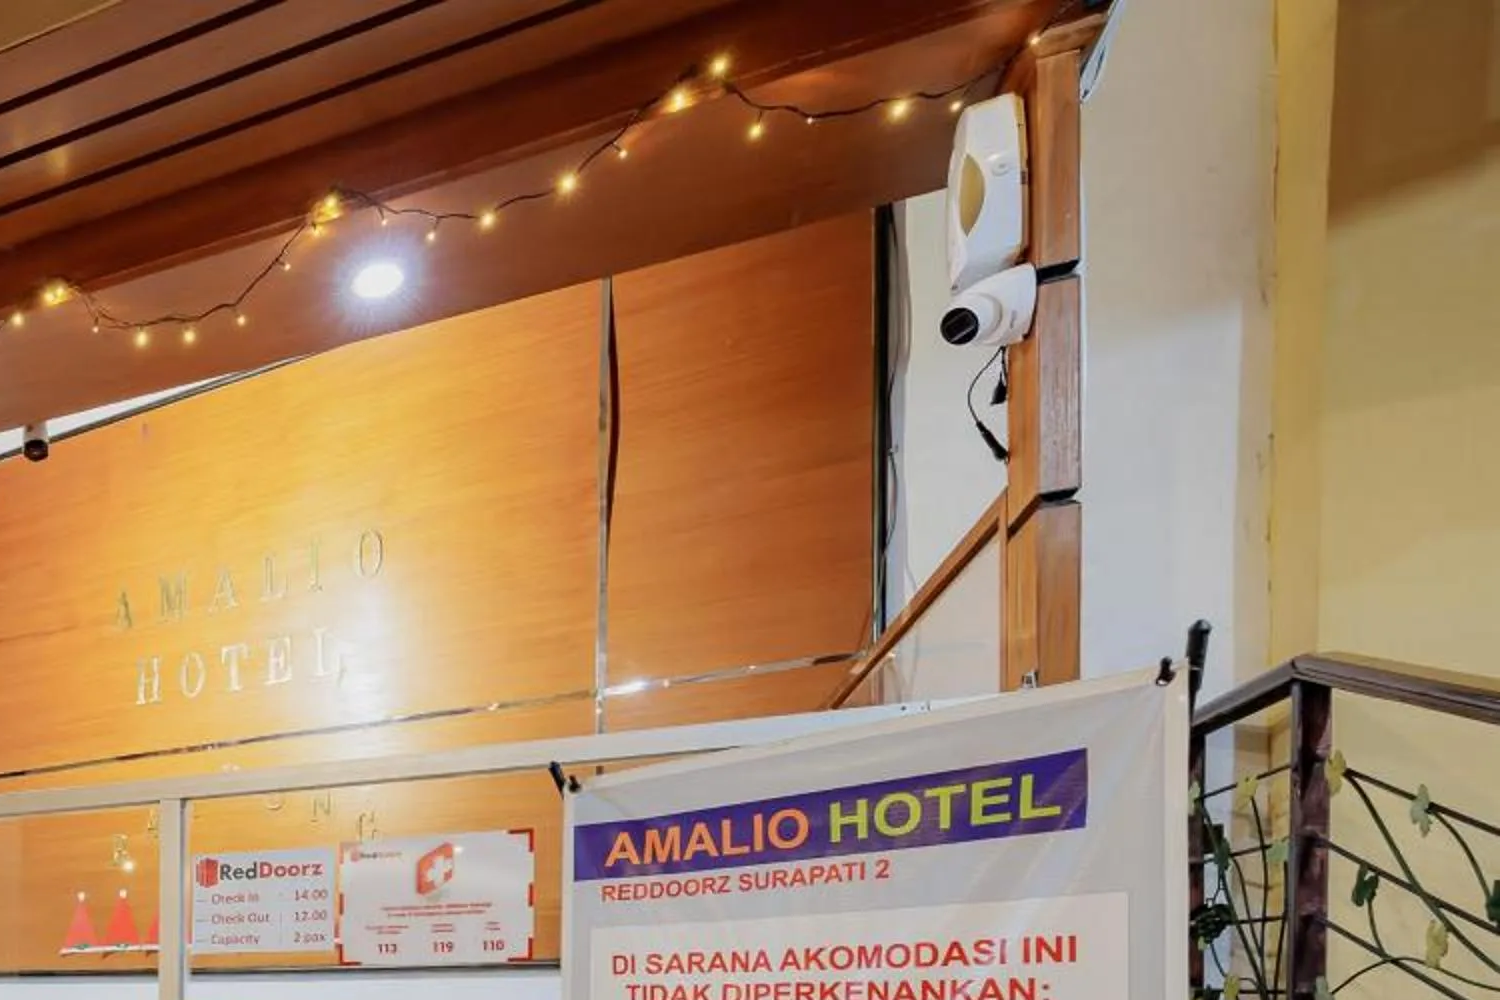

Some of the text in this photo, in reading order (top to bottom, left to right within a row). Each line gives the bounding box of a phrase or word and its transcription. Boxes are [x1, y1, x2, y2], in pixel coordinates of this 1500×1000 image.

[115, 529, 383, 628] AMALIO
[136, 627, 345, 704] HOTEL
[604, 773, 1062, 867] AMALIO HOTEL
[219, 861, 324, 881] RedDoorz
[601, 859, 890, 902] REDDOORZ SURAPATI 2
[211, 893, 245, 905] Check
[211, 913, 245, 925] Check
[247, 912, 269, 923] Out
[211, 933, 261, 946] Capacity
[377, 943, 398, 953] 113
[432, 941, 454, 952] 119
[612, 935, 1076, 976] DI SARANA AKOMODASI INI
